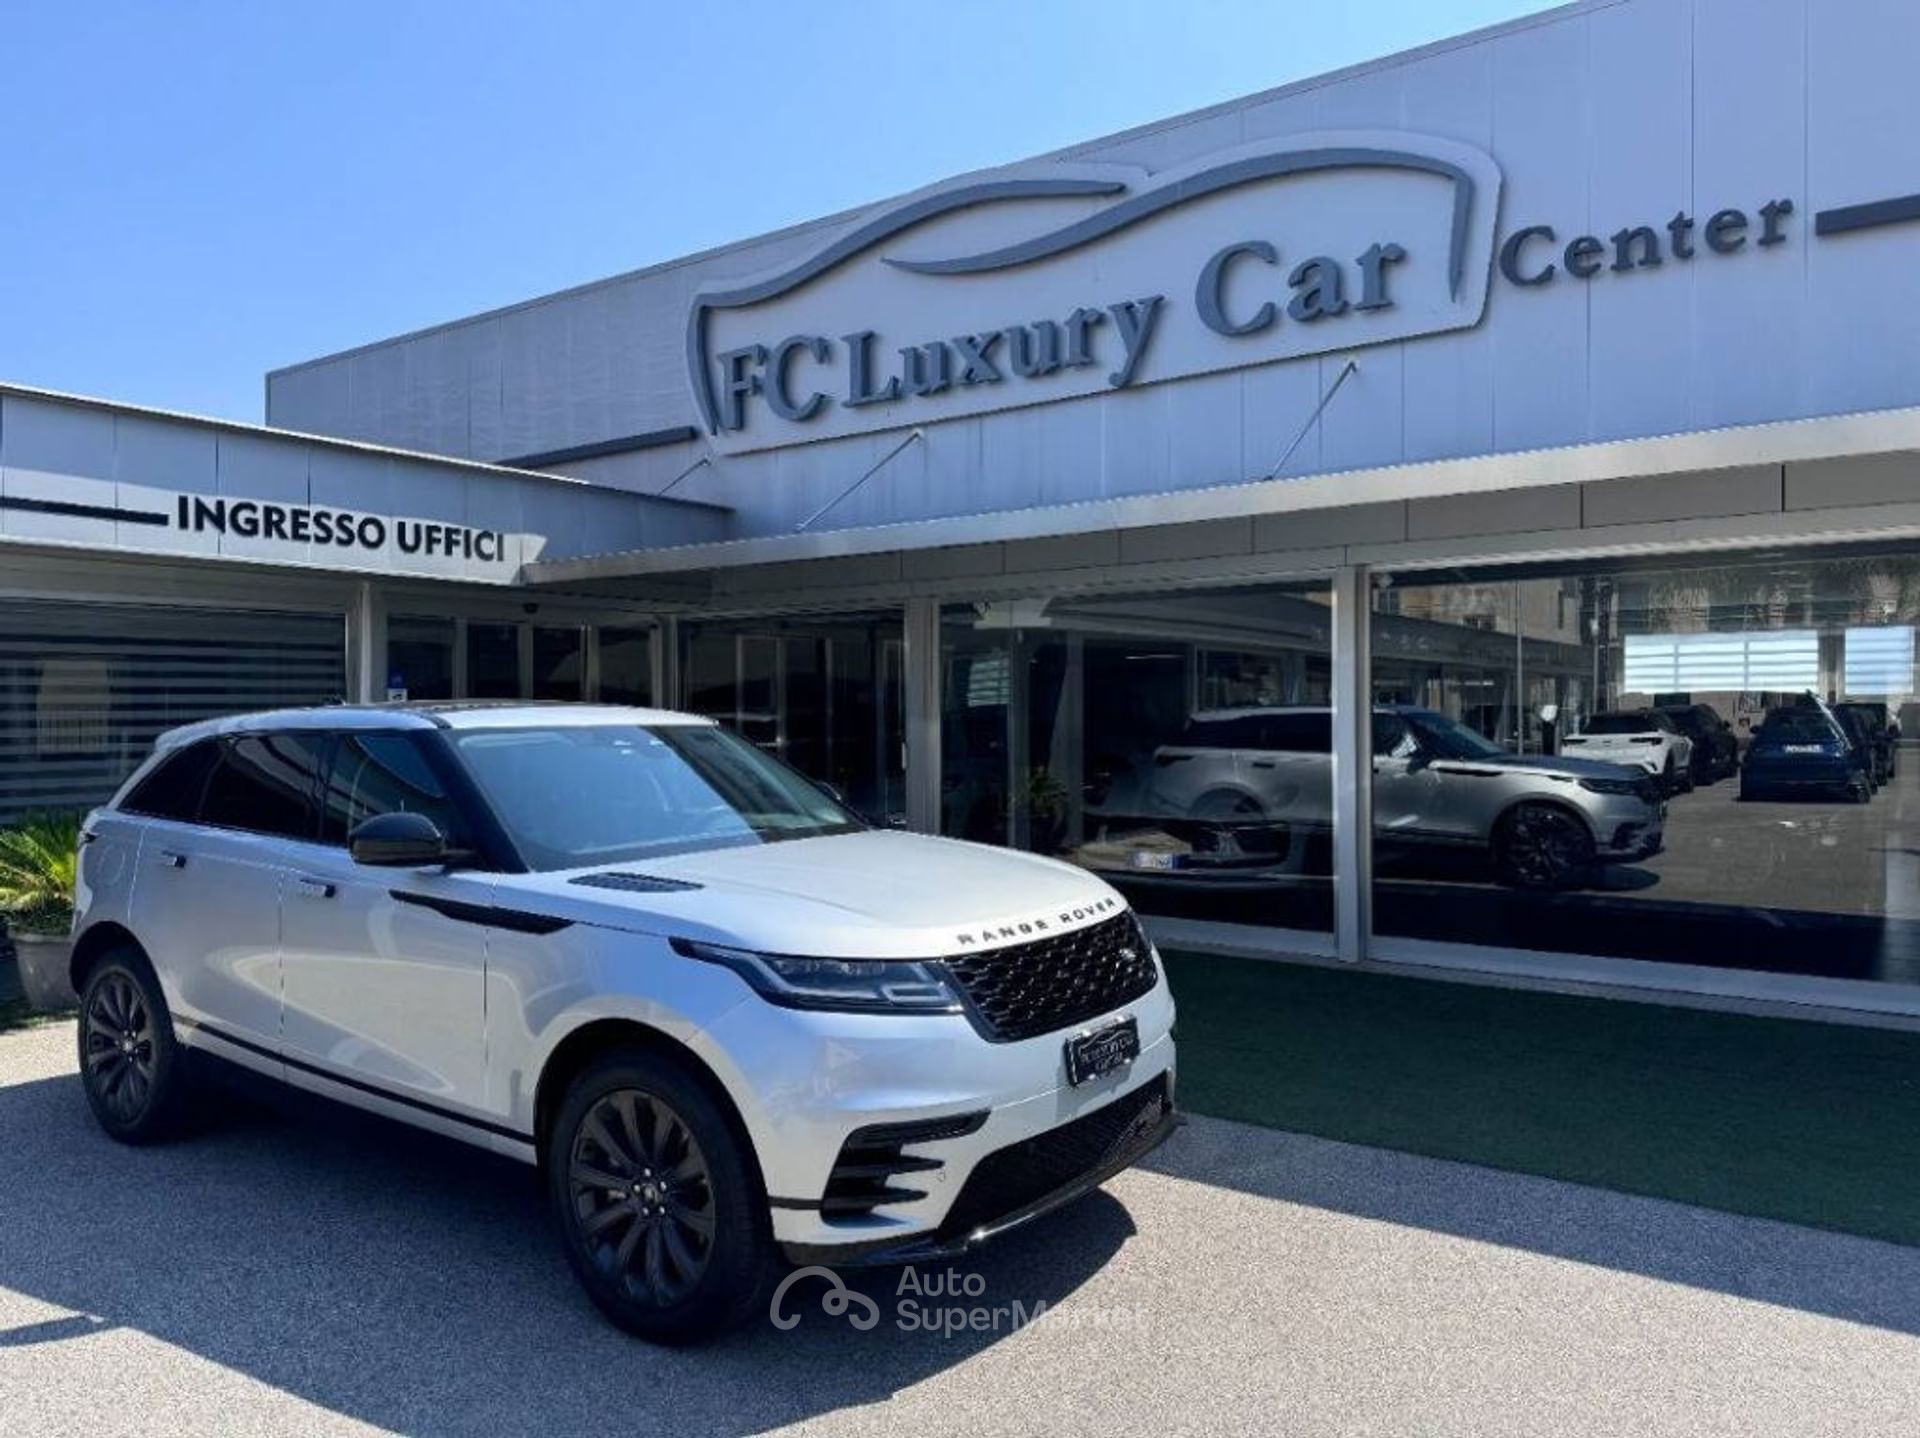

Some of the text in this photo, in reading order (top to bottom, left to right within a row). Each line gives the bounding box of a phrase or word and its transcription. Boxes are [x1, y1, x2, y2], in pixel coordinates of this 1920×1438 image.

[717, 197, 1794, 432] FC Luxury Car Center
[177, 494, 506, 563] INGRESSO UFFICI
[957, 898, 1115, 945] RANGE ROVER
